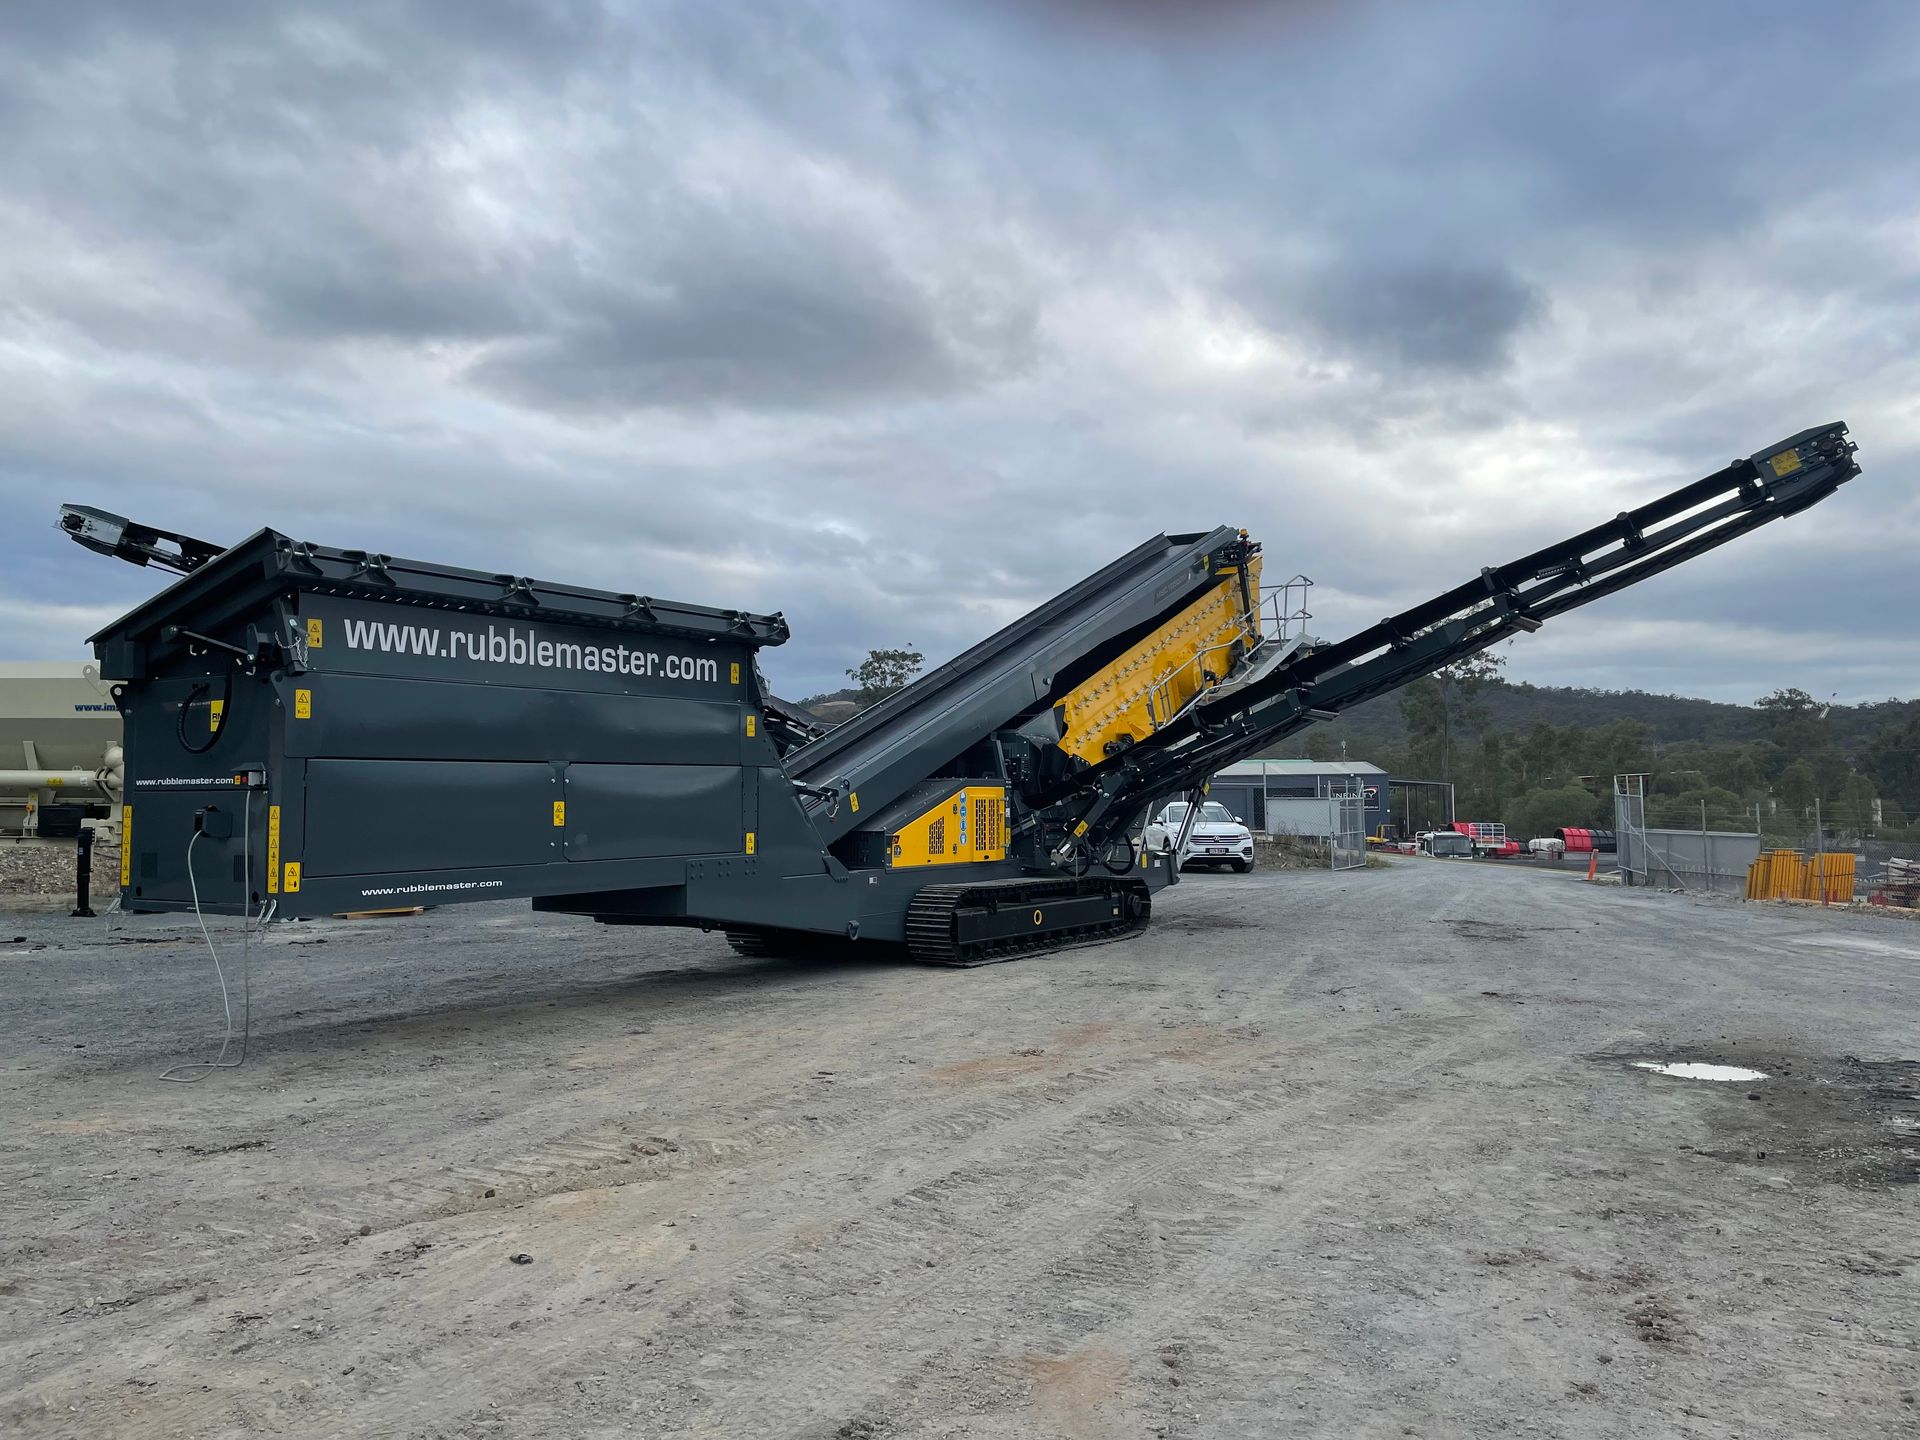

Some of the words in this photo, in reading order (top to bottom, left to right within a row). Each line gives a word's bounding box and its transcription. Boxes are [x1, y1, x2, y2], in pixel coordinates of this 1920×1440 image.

[344, 618, 718, 683] www.rubblemaster.com
[74, 702, 119, 712] www.im
[136, 777, 234, 786] www.rubblemaster.com
[361, 880, 503, 896] www.rubblemaster.com
